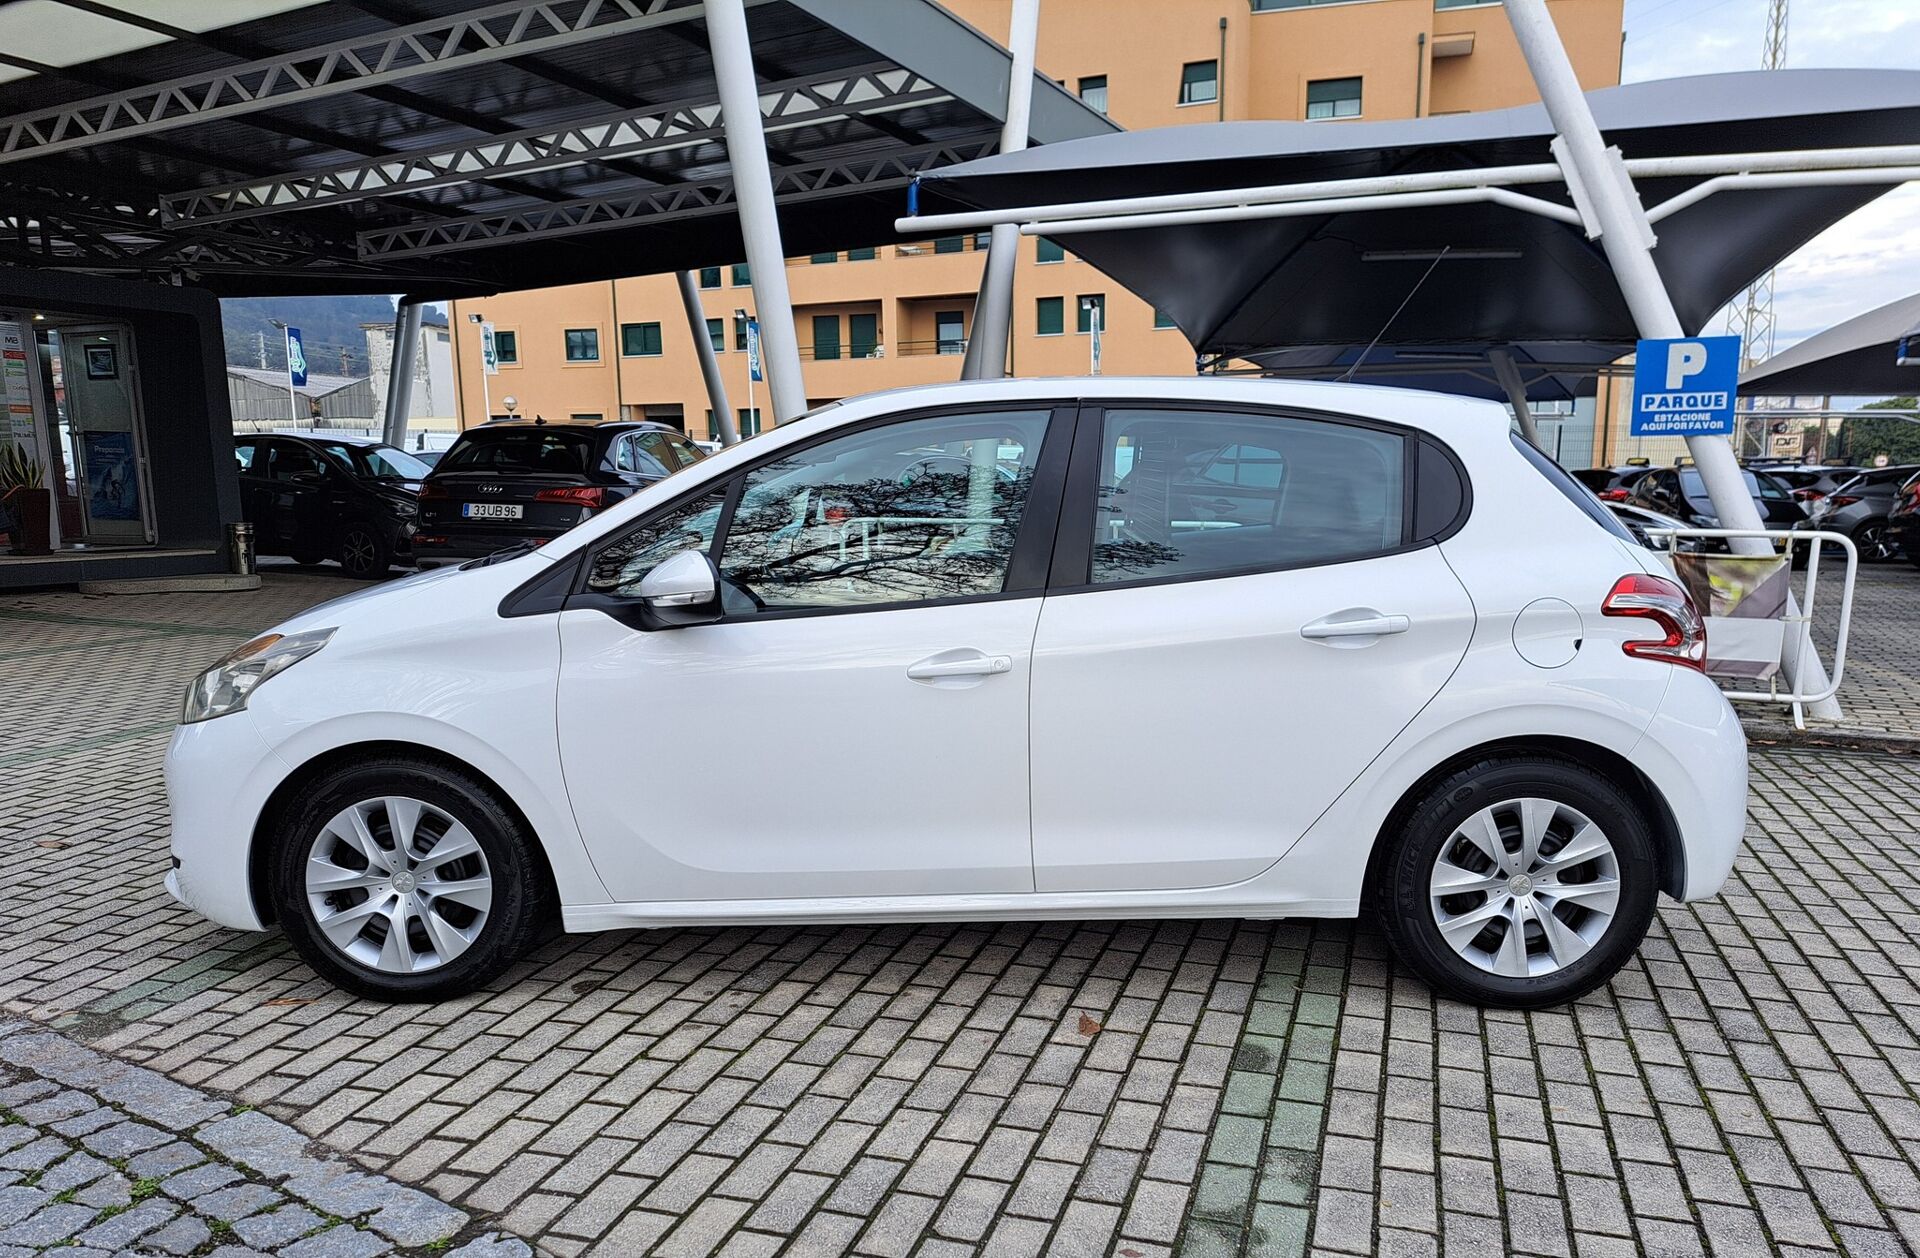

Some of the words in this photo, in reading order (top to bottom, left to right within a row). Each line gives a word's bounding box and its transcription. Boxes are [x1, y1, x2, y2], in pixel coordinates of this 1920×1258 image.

[1665, 342, 1707, 389] P
[1644, 394, 1724, 409] PARQUE
[1654, 412, 1712, 422] ESTACIONE
[1640, 422, 1666, 431] AQUI
[1666, 421, 1688, 430] POR
[1688, 420, 1724, 430] FAVOR
